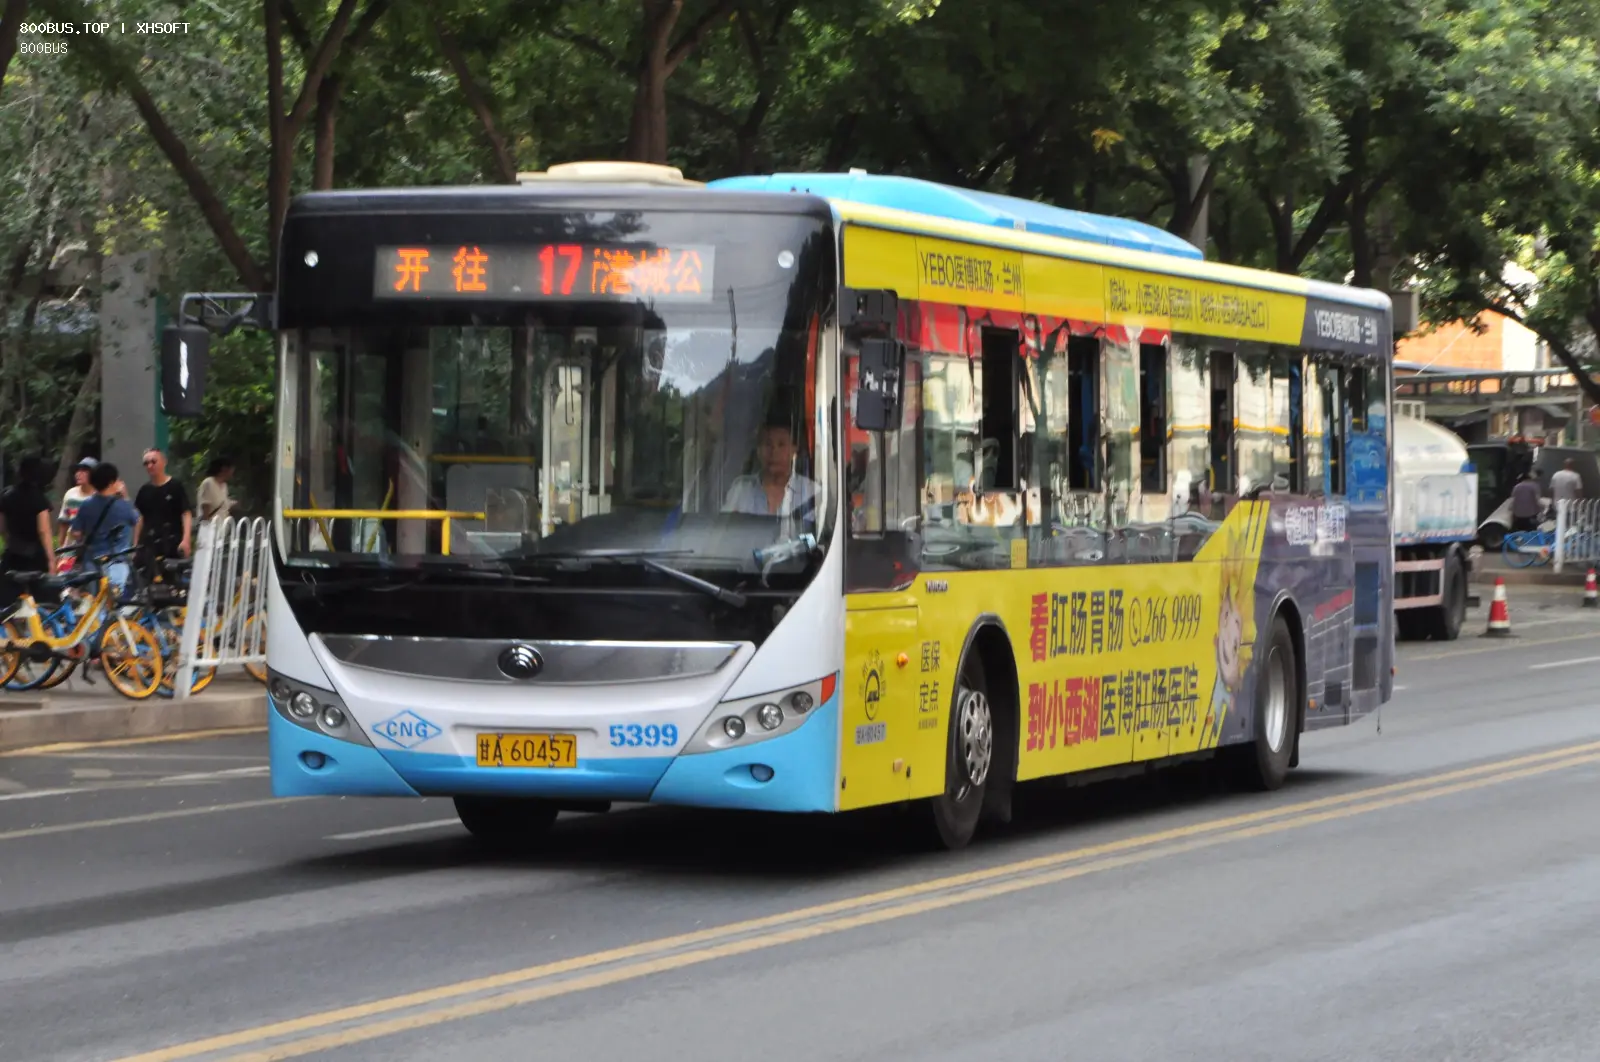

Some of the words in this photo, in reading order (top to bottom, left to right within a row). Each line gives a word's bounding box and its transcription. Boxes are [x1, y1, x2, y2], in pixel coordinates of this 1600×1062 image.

[539, 244, 582, 294] 17
[1029, 589, 1124, 663] 看肛肠胃肠
[1143, 596, 1168, 643] 266
[1172, 594, 1202, 641] 9999
[921, 640, 940, 672] 医保
[919, 680, 939, 713] 定点
[1026, 662, 1199, 752] 到小西湖医博肛肠医院
[386, 720, 429, 739] CNG
[608, 723, 679, 747] 5399
